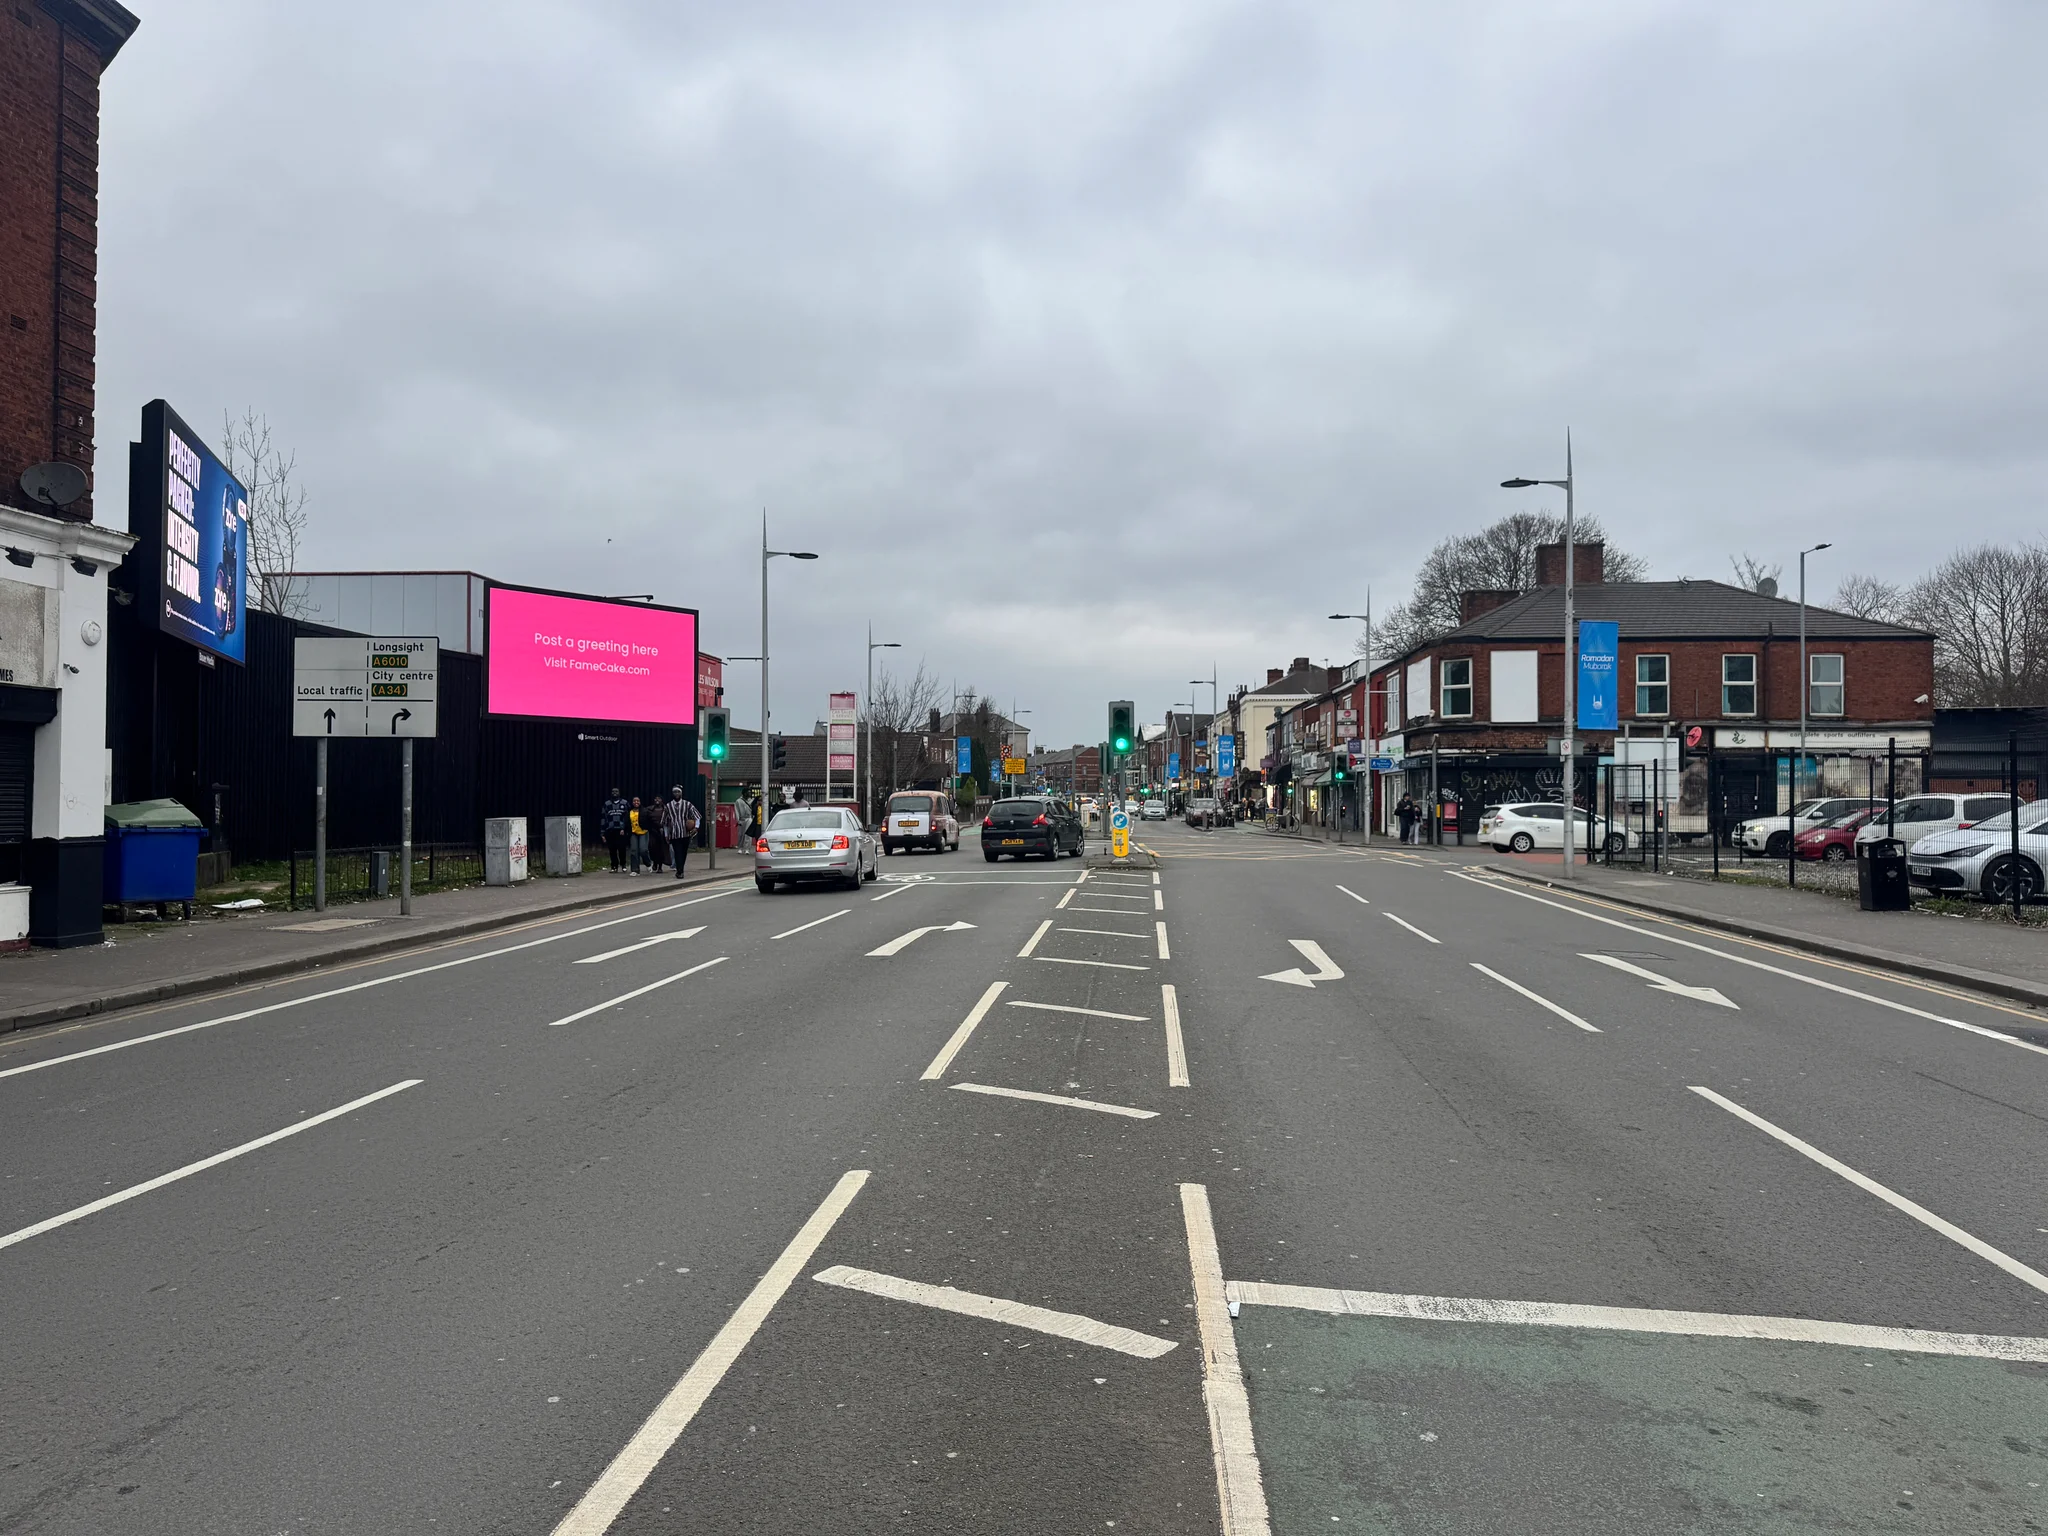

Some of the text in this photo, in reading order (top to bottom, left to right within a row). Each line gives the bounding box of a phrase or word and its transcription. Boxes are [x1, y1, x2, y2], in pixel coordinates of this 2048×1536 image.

[169, 428, 201, 491] PERFECTLY
[168, 468, 194, 524] PACKED:
[225, 507, 237, 533] zone
[167, 508, 199, 564] INTENSITY
[166, 549, 173, 588] &
[214, 587, 227, 612] zone
[373, 642, 424, 653] Longsight
[534, 632, 658, 657] Post a greeting here
[373, 657, 408, 666] A6010
[544, 656, 650, 676] Visit FameCake.com
[1581, 654, 1614, 662] Ramadan
[1583, 662, 1612, 670] Mubarak
[372, 671, 434, 682] City centre
[297, 686, 363, 695] Local traffic
[372, 685, 407, 696] (A34)
